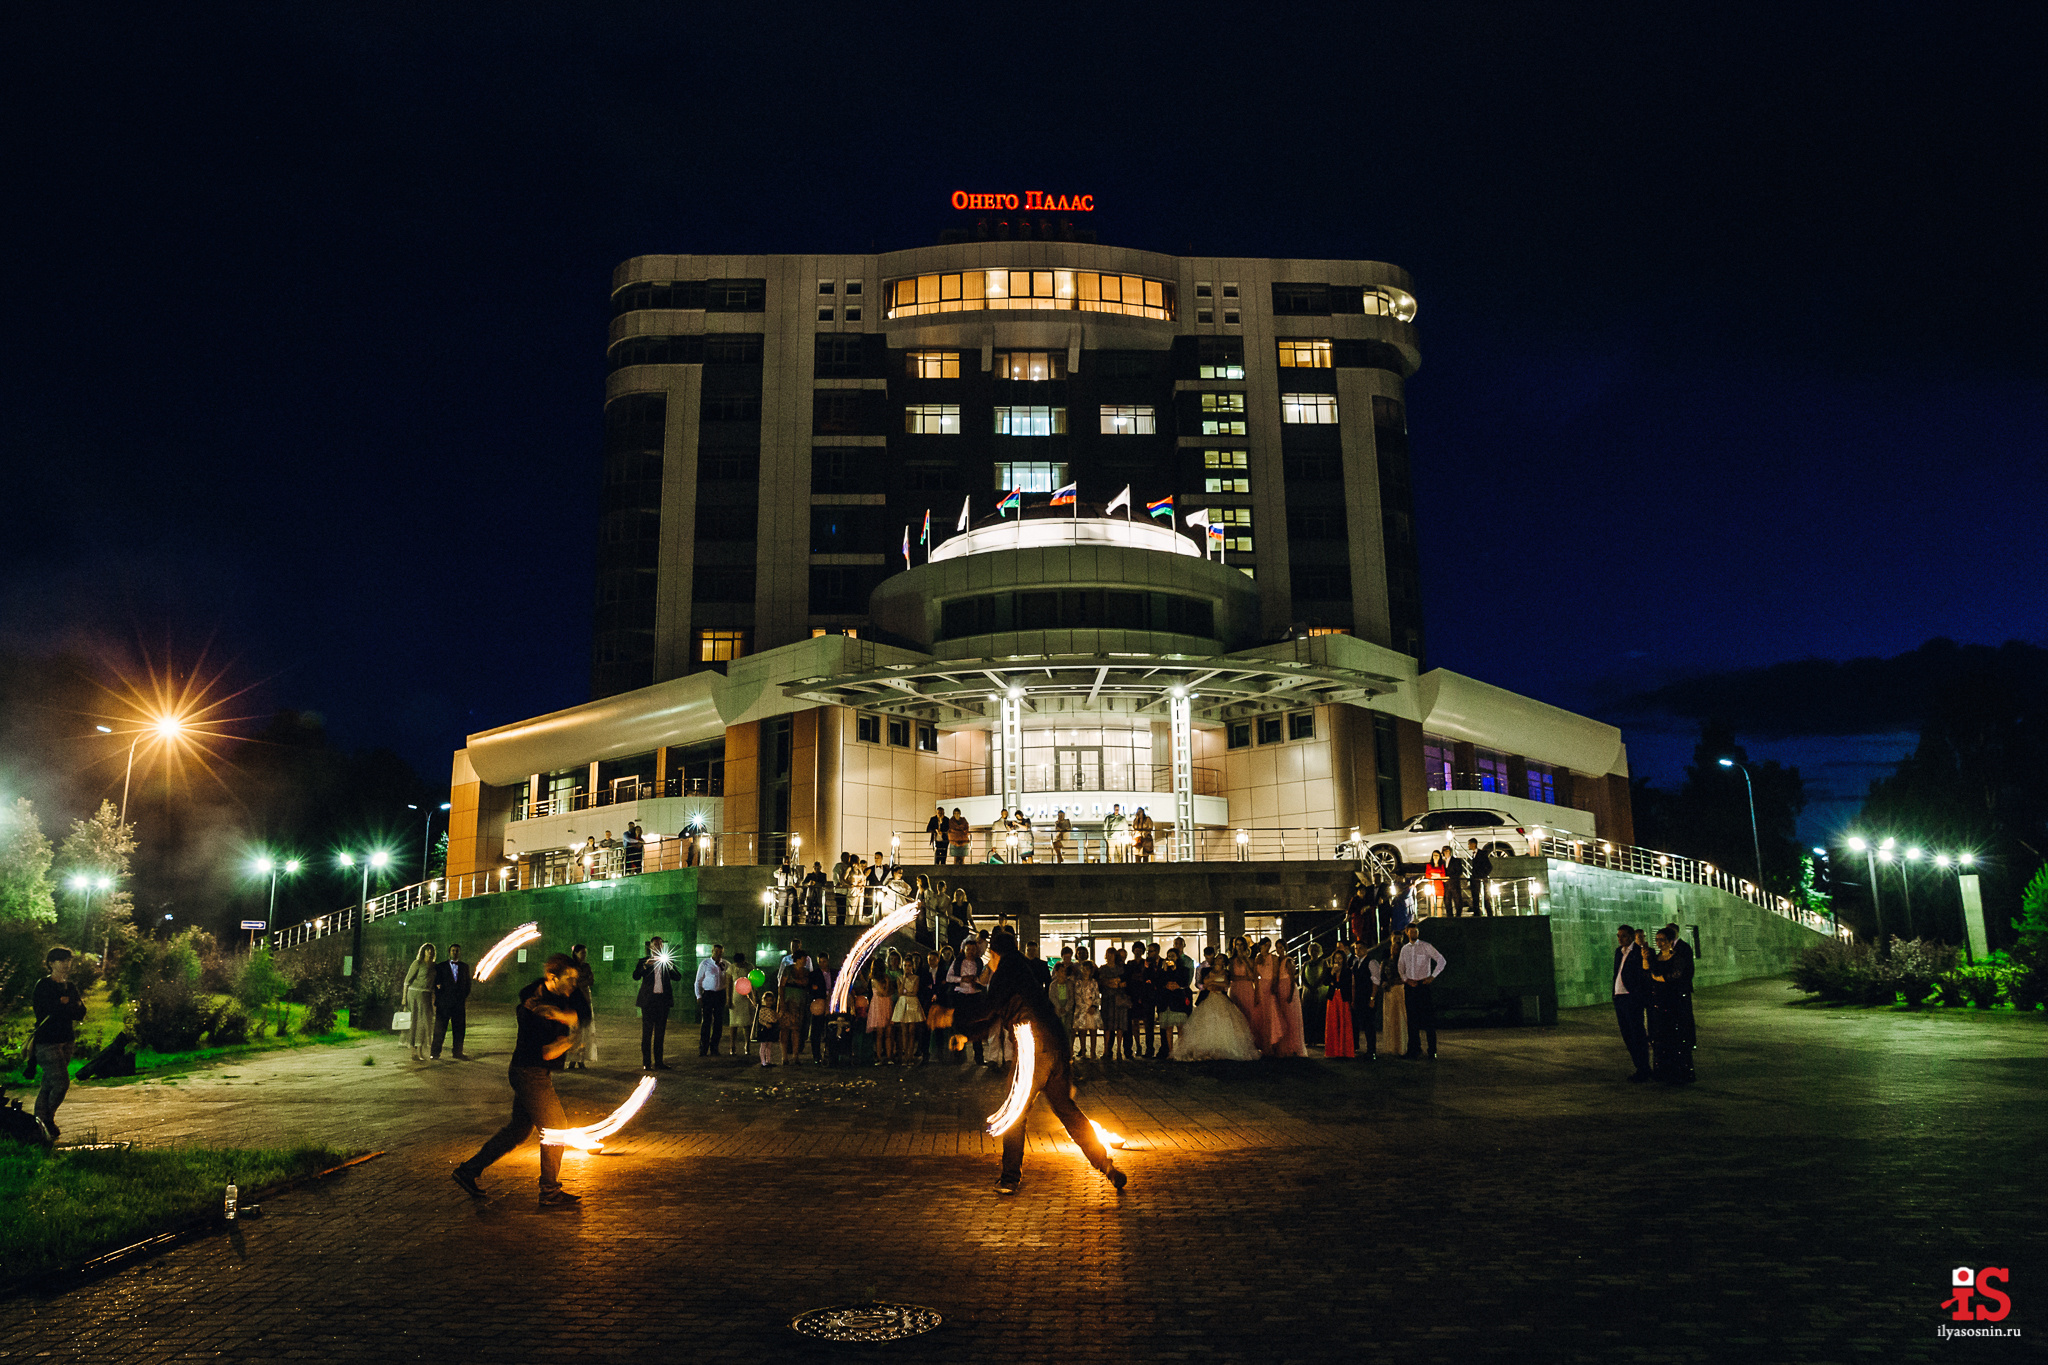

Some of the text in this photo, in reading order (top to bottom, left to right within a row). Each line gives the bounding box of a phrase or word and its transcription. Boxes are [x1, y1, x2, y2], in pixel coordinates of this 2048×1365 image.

[951, 190, 1095, 212] ОНЕГО ПАЛАС
[1023, 803, 1084, 817] ОНЕГО
